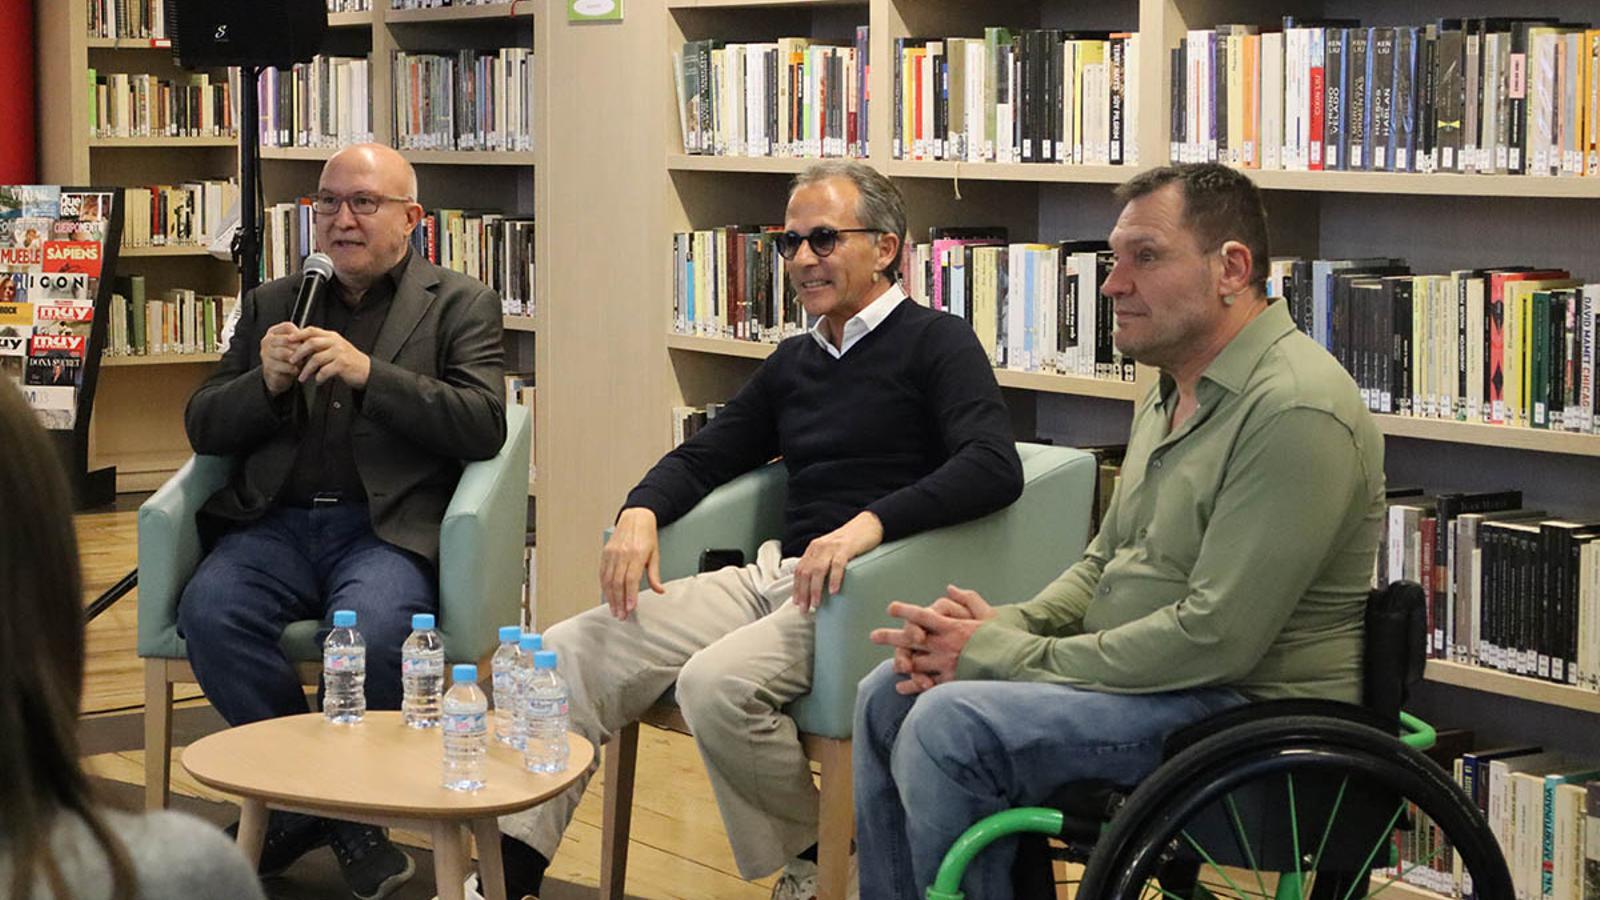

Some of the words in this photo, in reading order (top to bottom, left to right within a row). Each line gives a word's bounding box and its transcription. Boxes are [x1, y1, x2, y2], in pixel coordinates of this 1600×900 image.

[1383, 88, 1391, 136] HABLAN
[1, 248, 40, 264] MUEBLE
[47, 244, 98, 260] SÀPIENS
[30, 276, 84, 289] ICON
[40, 307, 90, 320] muy
[1583, 297, 1592, 327] DAVID
[0, 339, 22, 349] uy
[33, 336, 82, 349] muy
[1582, 367, 1591, 407] CHICAG
